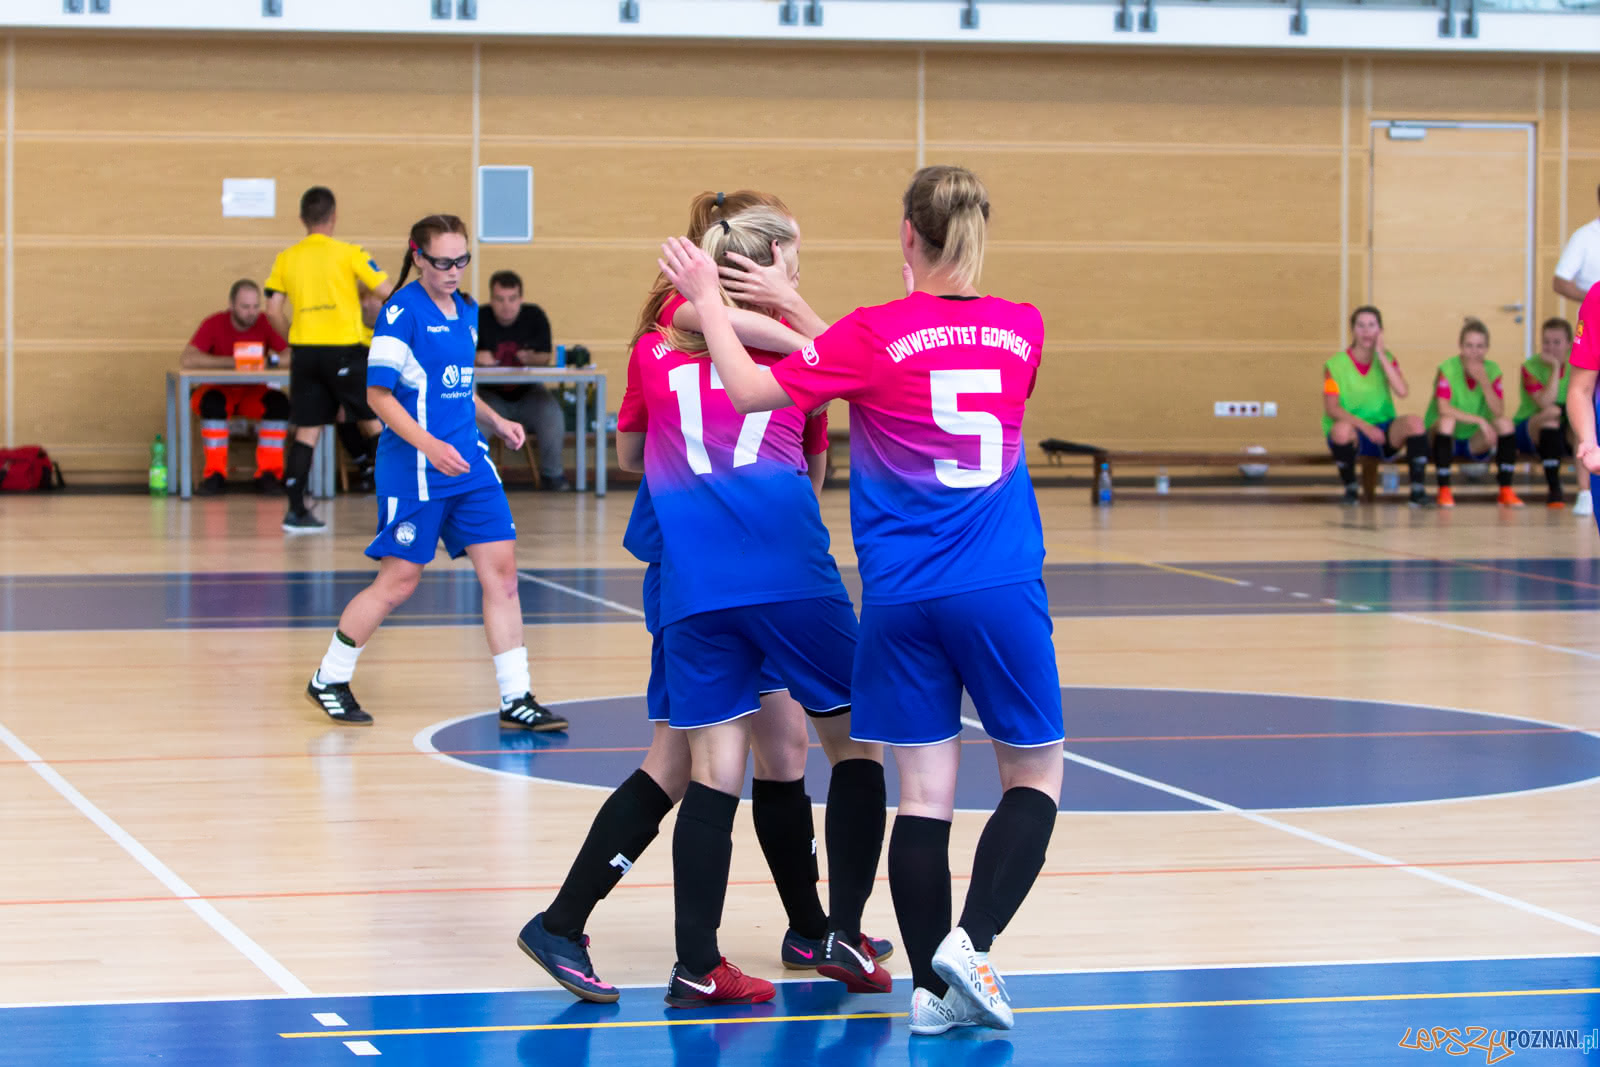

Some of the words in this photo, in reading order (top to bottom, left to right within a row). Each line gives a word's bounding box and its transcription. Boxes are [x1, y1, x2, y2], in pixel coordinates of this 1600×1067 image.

[885, 325, 977, 363] UNIWERSYTET
[981, 326, 1032, 362] GDAŃSKI
[668, 362, 773, 476] 17
[929, 369, 1003, 488] 5
